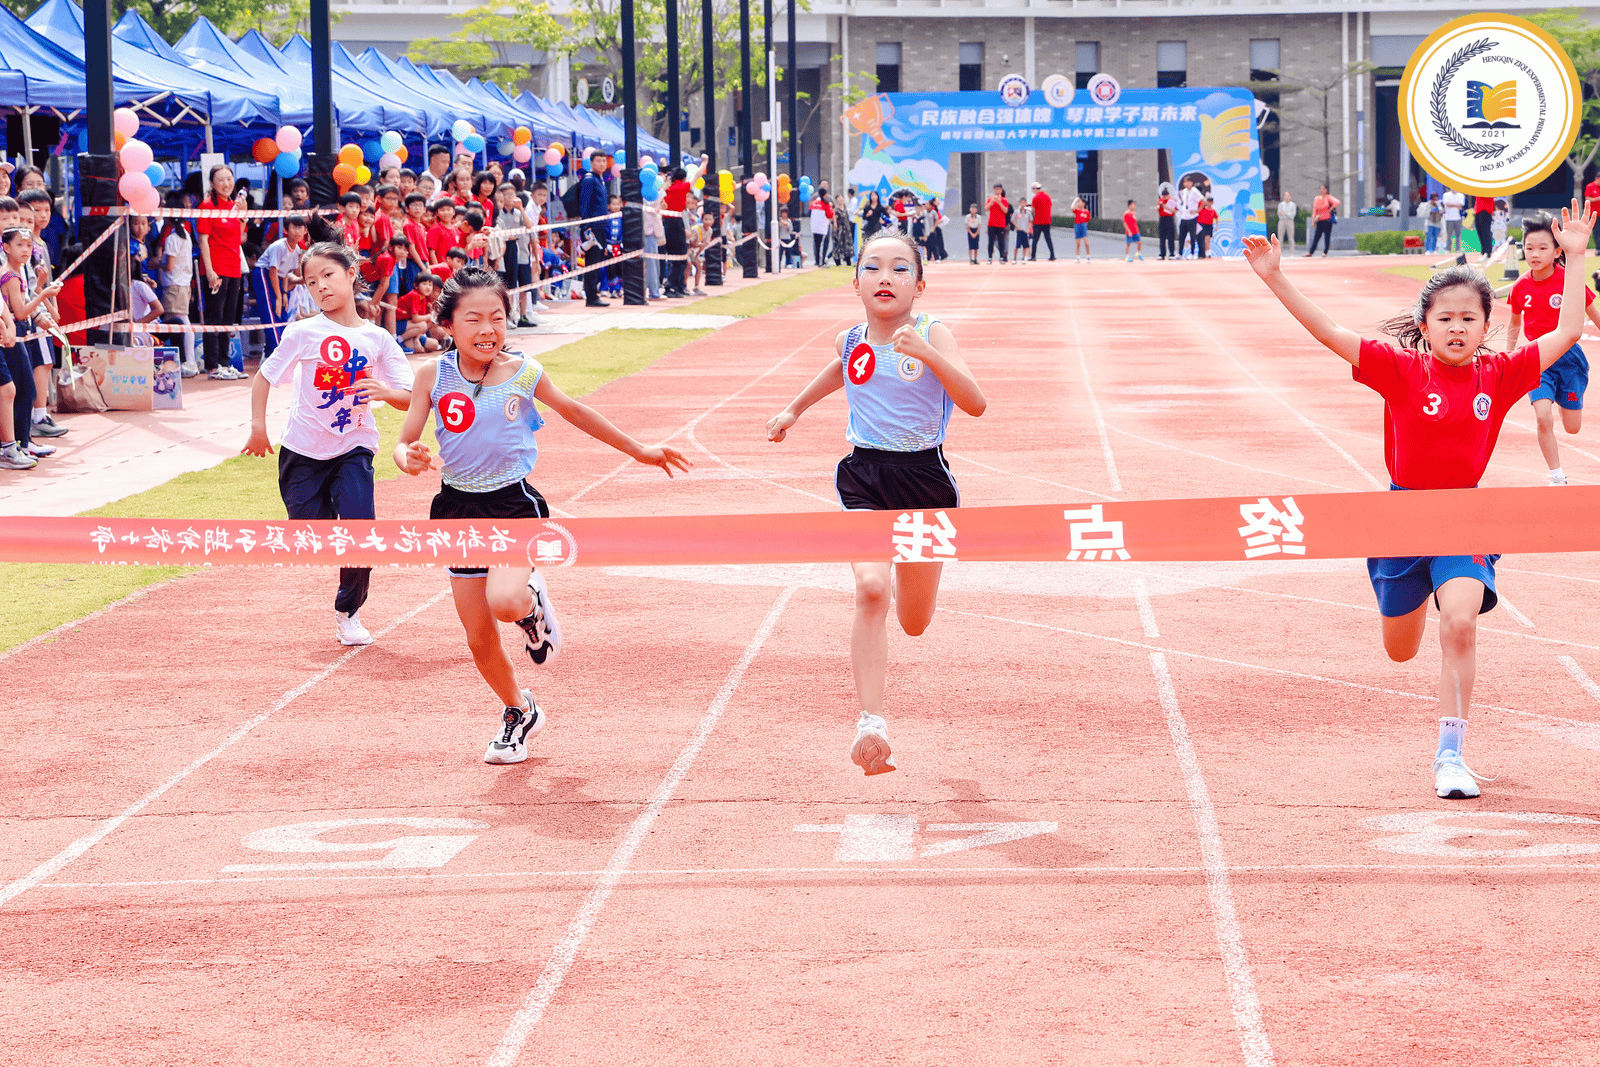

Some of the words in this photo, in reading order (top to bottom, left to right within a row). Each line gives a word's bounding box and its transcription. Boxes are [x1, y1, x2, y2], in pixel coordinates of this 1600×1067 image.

[921, 107, 1052, 126] 民族融合强体魄
[1066, 105, 1197, 123] 琴澳学子筑未来
[1524, 294, 1532, 307] 2
[327, 340, 344, 362] 6
[852, 352, 871, 379] 4
[445, 398, 466, 426] 5
[1422, 392, 1442, 416] 3
[221, 817, 490, 873] 5
[793, 813, 1059, 863] 4
[1357, 811, 1600, 857] 3
